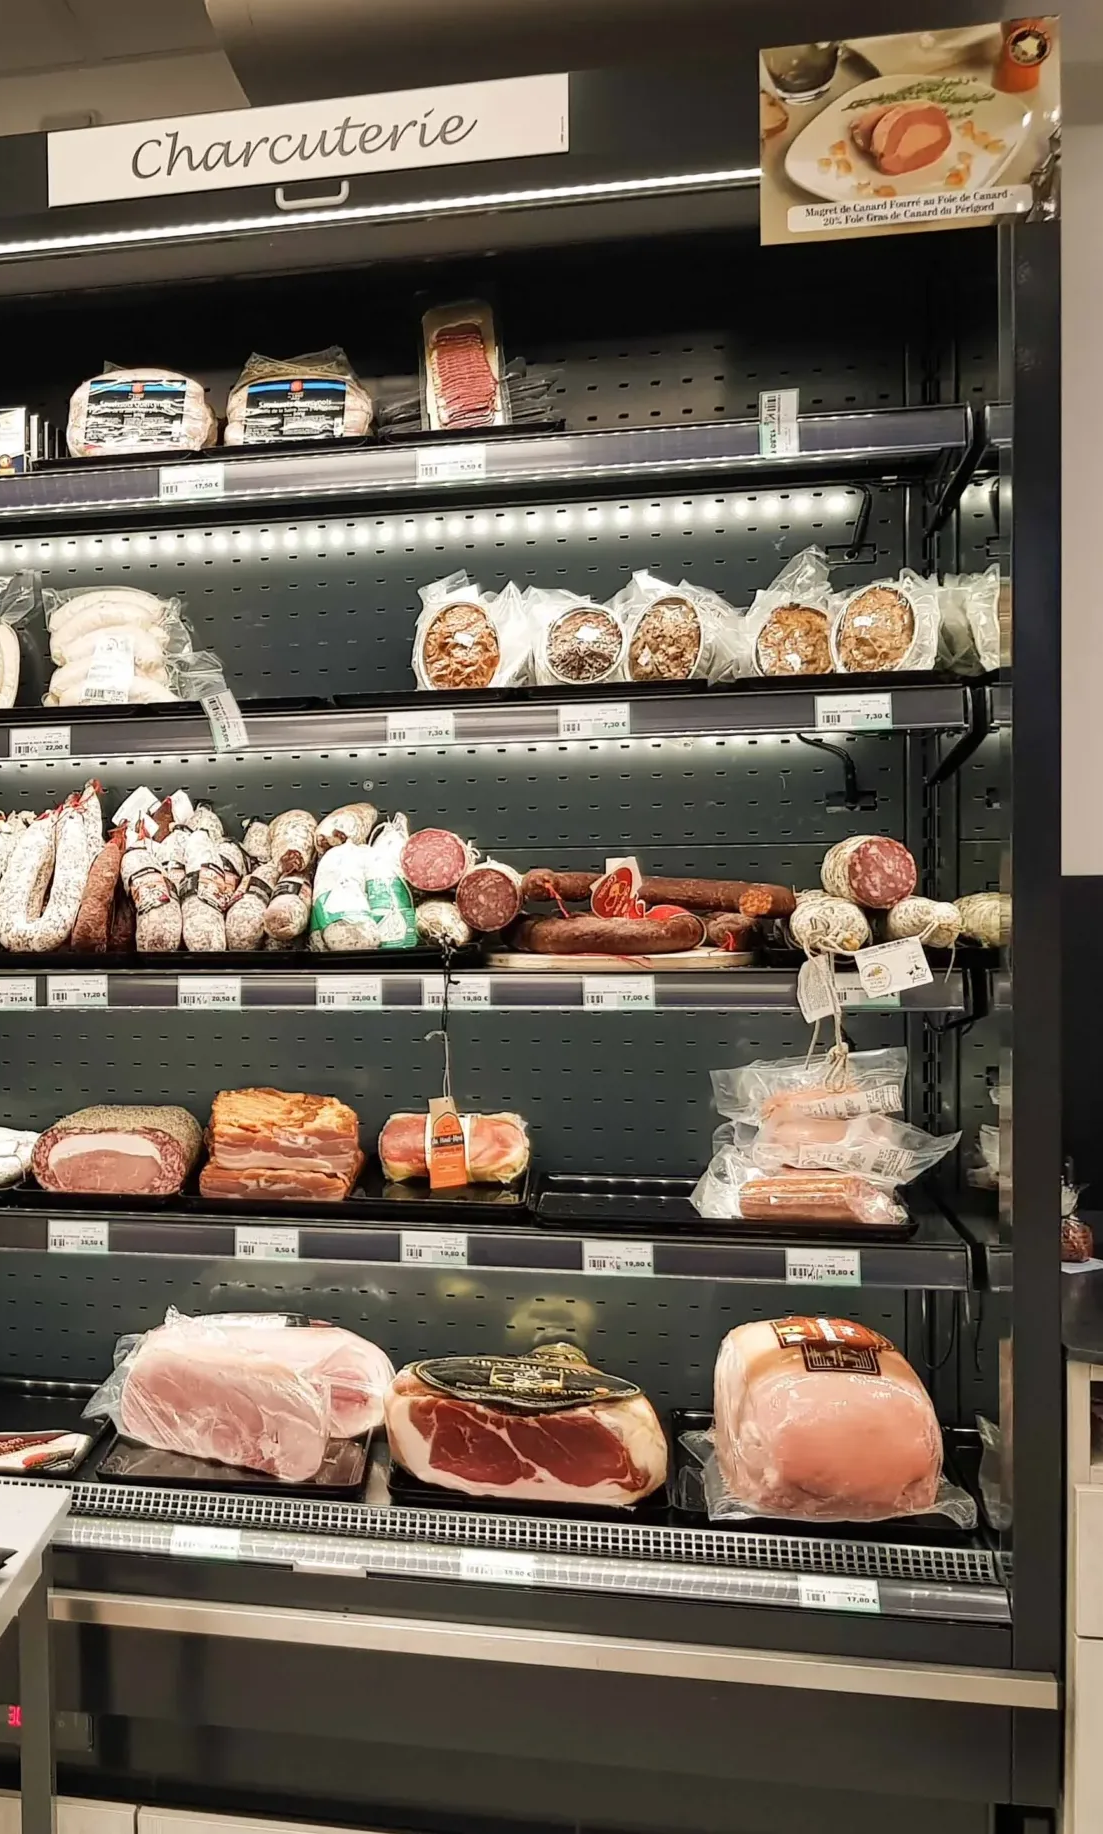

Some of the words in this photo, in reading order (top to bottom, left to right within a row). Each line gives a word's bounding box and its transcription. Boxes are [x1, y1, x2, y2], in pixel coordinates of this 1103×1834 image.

[131, 108, 477, 179] Charcuterie
[805, 206, 838, 217] Magret
[840, 204, 851, 214] de
[853, 201, 887, 213] Canard
[889, 197, 921, 210] Fourré
[923, 198, 935, 207] au
[937, 195, 957, 205] Foie
[959, 193, 970, 203] de
[973, 189, 1008, 201] Canard
[823, 216, 842, 227] 20%
[845, 213, 865, 224] Foie
[866, 211, 888, 222] Gras
[890, 210, 902, 220] de
[904, 207, 938, 219] Canard
[940, 206, 951, 216] du
[955, 202, 994, 215] Périgord
[547, 1387, 596, 1396] Parma
